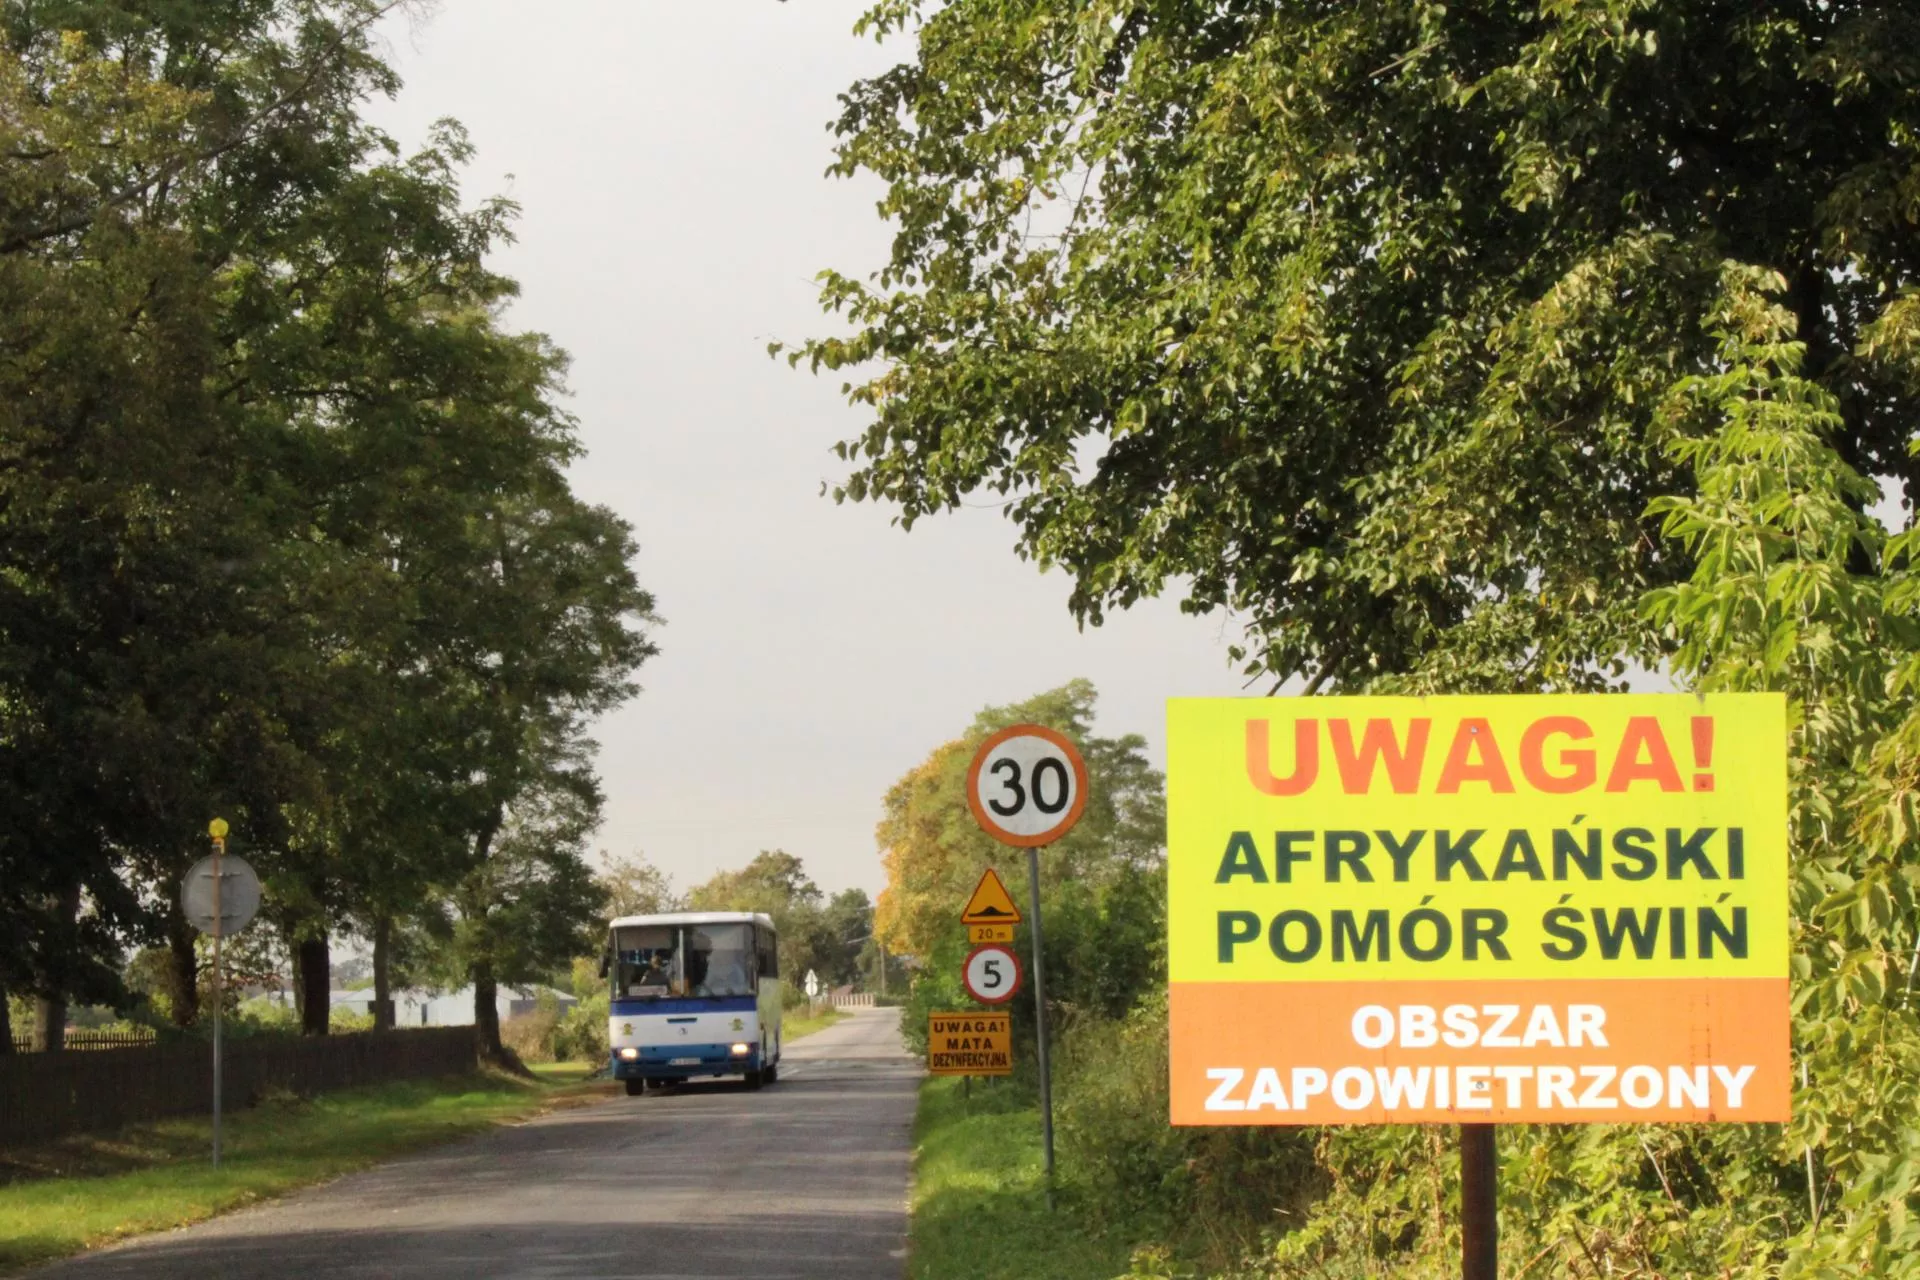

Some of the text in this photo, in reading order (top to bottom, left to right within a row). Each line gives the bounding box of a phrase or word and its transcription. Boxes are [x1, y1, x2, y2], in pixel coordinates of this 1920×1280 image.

[1245, 715, 1715, 797] UWAGA!
[988, 757, 1069, 817] 30
[1214, 814, 1745, 884] AFRYKAŃSKI
[978, 928, 993, 939] 20
[1216, 892, 1749, 964] POMÓR ŚWIŃ
[983, 960, 1001, 989] 5
[934, 1021, 1005, 1033] UWAGA!
[946, 1037, 993, 1050] MATA
[1350, 1003, 1610, 1050] OBSZAR
[933, 1052, 1007, 1068] DEZYNFEKCYJNA
[1204, 1064, 1757, 1112] ZAPOWIETRZONY
